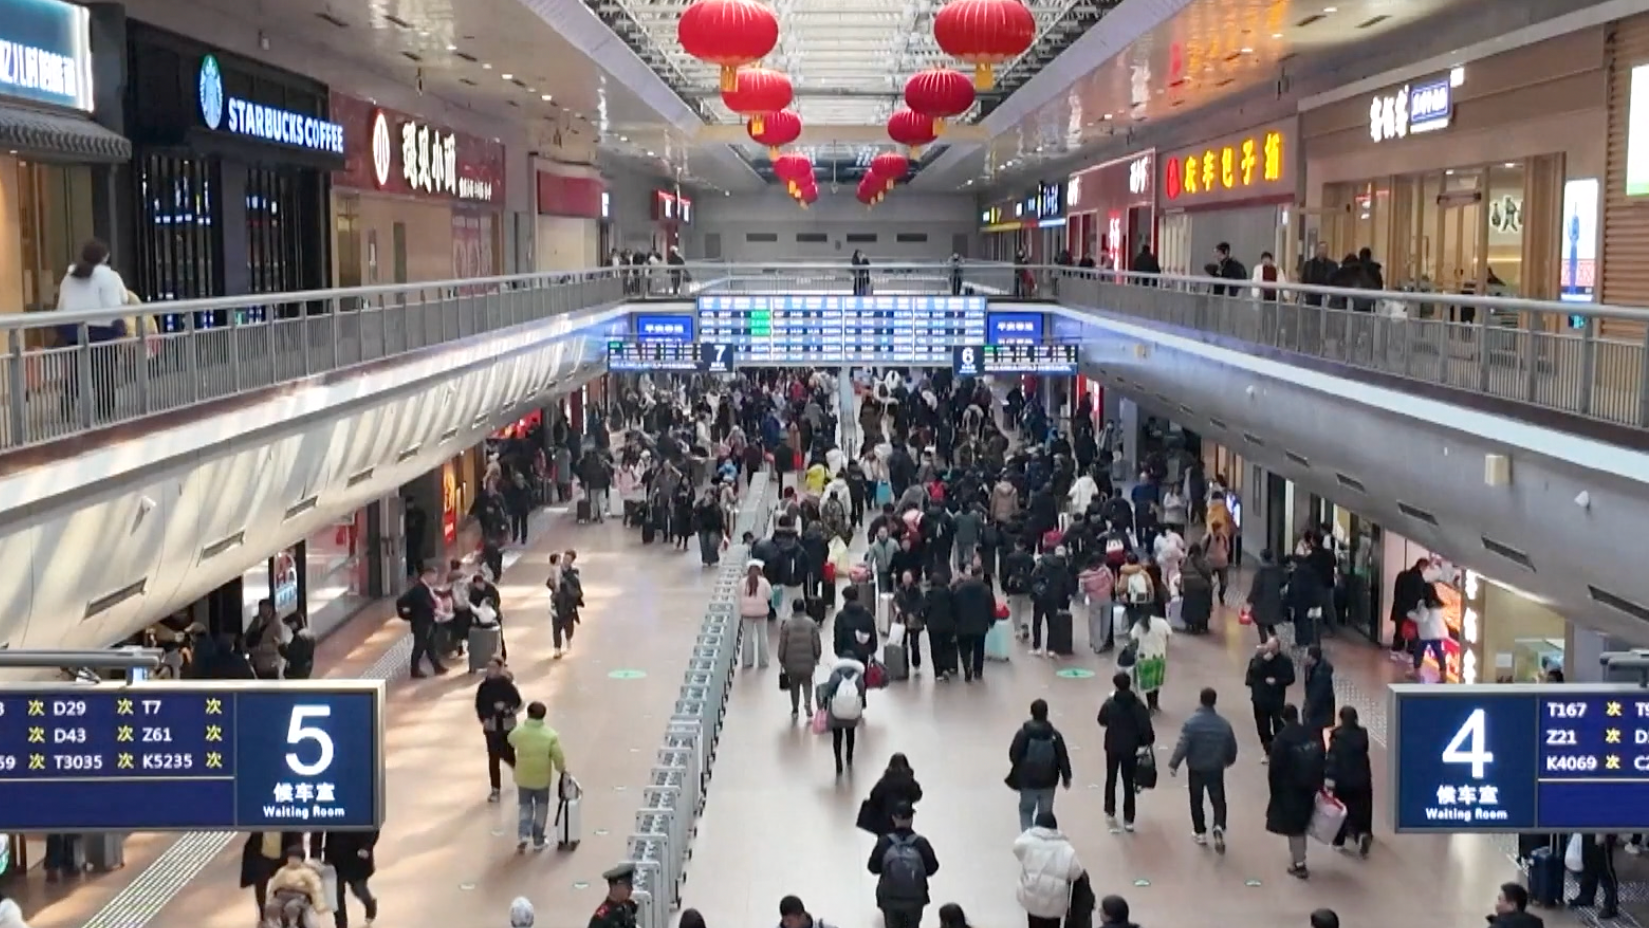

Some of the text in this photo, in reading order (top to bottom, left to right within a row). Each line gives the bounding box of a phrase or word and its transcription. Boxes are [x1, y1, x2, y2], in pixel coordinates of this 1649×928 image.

[228, 97, 344, 154] STARBUCKS COFFEE
[713, 344, 726, 363] 7
[961, 346, 974, 365] 6
[28, 699, 45, 716] 次
[53, 700, 87, 716] D29
[117, 698, 134, 715] 次
[141, 699, 162, 715] T7
[205, 698, 222, 715] 次
[1547, 702, 1587, 718] T167
[1606, 701, 1622, 717] 次
[28, 725, 223, 744] 次 D43 次 Z61 次
[286, 704, 334, 776] 5
[1441, 708, 1494, 779] 4
[1546, 727, 1649, 745] Z21 次 D
[28, 753, 46, 770] 次
[53, 754, 103, 770] T3035
[117, 752, 134, 769] 次
[142, 753, 193, 769] K5235
[205, 751, 223, 768] 次
[1546, 755, 1598, 771] K4069
[1605, 754, 1621, 770] 次
[273, 782, 335, 803] 候车室
[1436, 784, 1499, 806] 候车室
[263, 804, 345, 820] Waiting Room
[1425, 807, 1508, 822] Waiting Room
